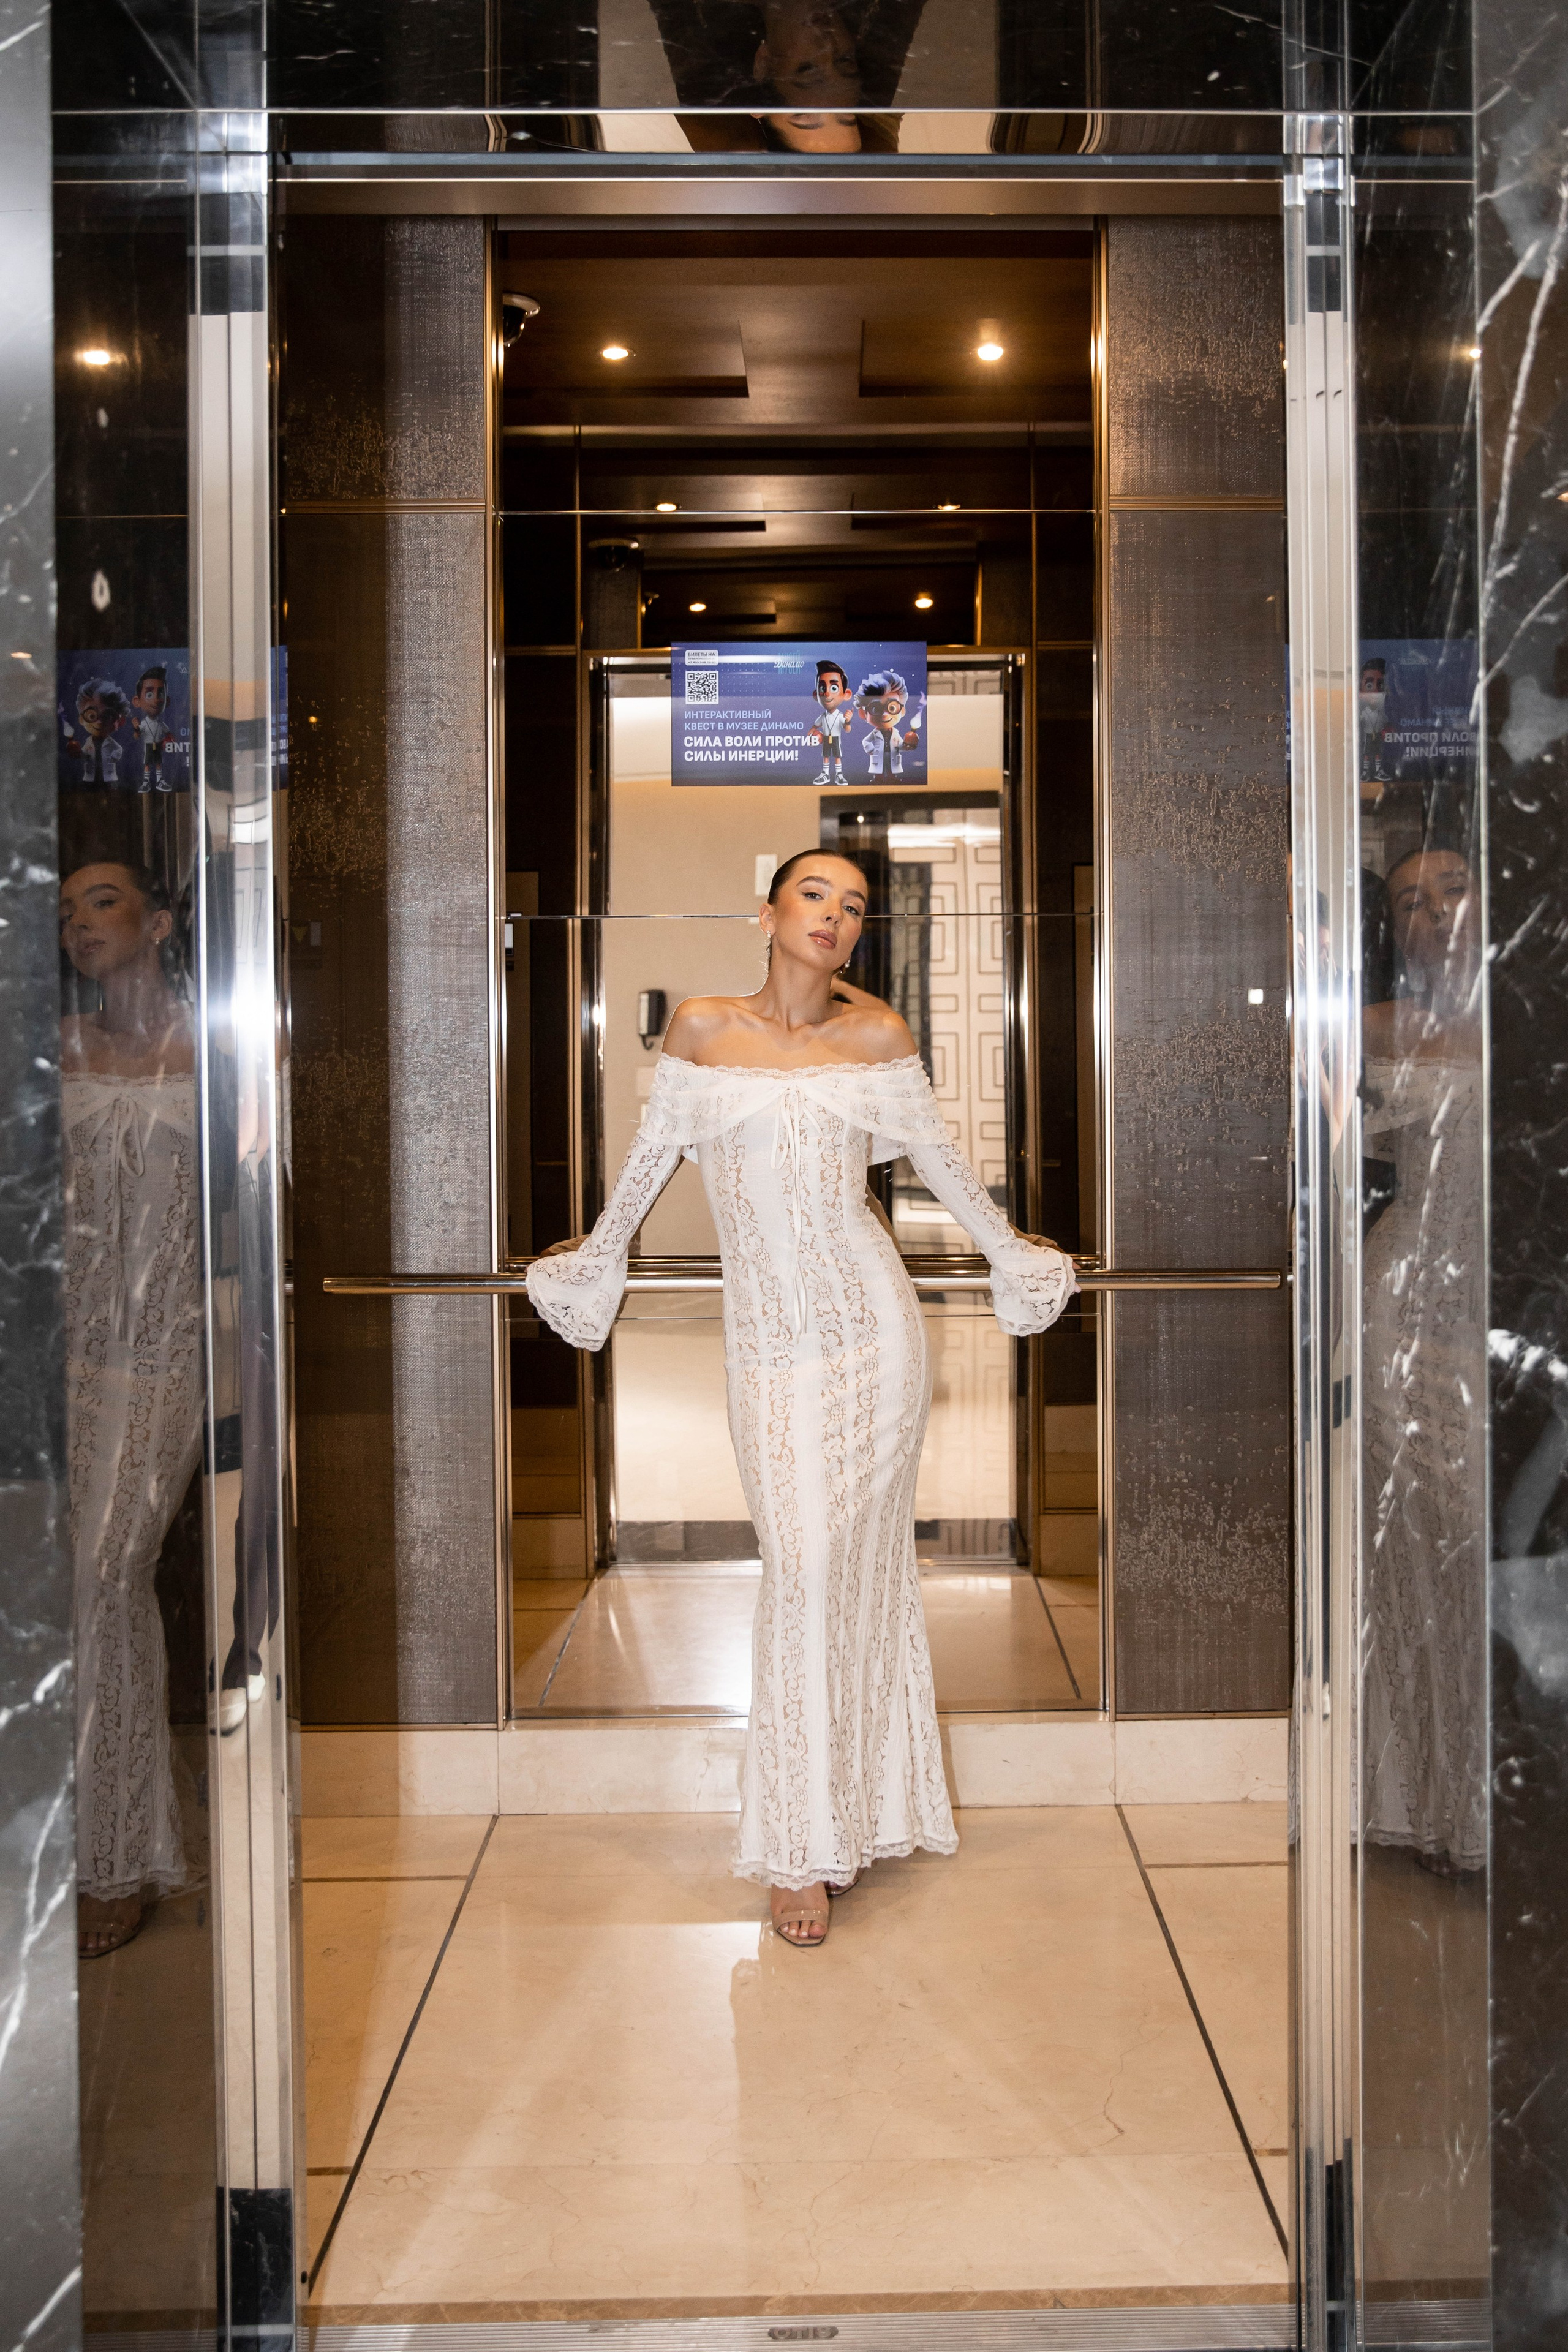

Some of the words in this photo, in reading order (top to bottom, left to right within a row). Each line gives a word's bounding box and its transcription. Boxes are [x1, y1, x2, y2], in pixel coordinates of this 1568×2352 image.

[684, 709, 771, 719] ИНТЕРАКТИВНЫЙ
[761, 722, 804, 731] ДИНАМО
[684, 736, 722, 747] СИЛА
[725, 736, 761, 747] ВОЛИ
[766, 735, 820, 746] ПРОТИВ
[684, 750, 725, 761] СИЛЫ
[729, 750, 799, 763] ИНЕРЦИИ!
